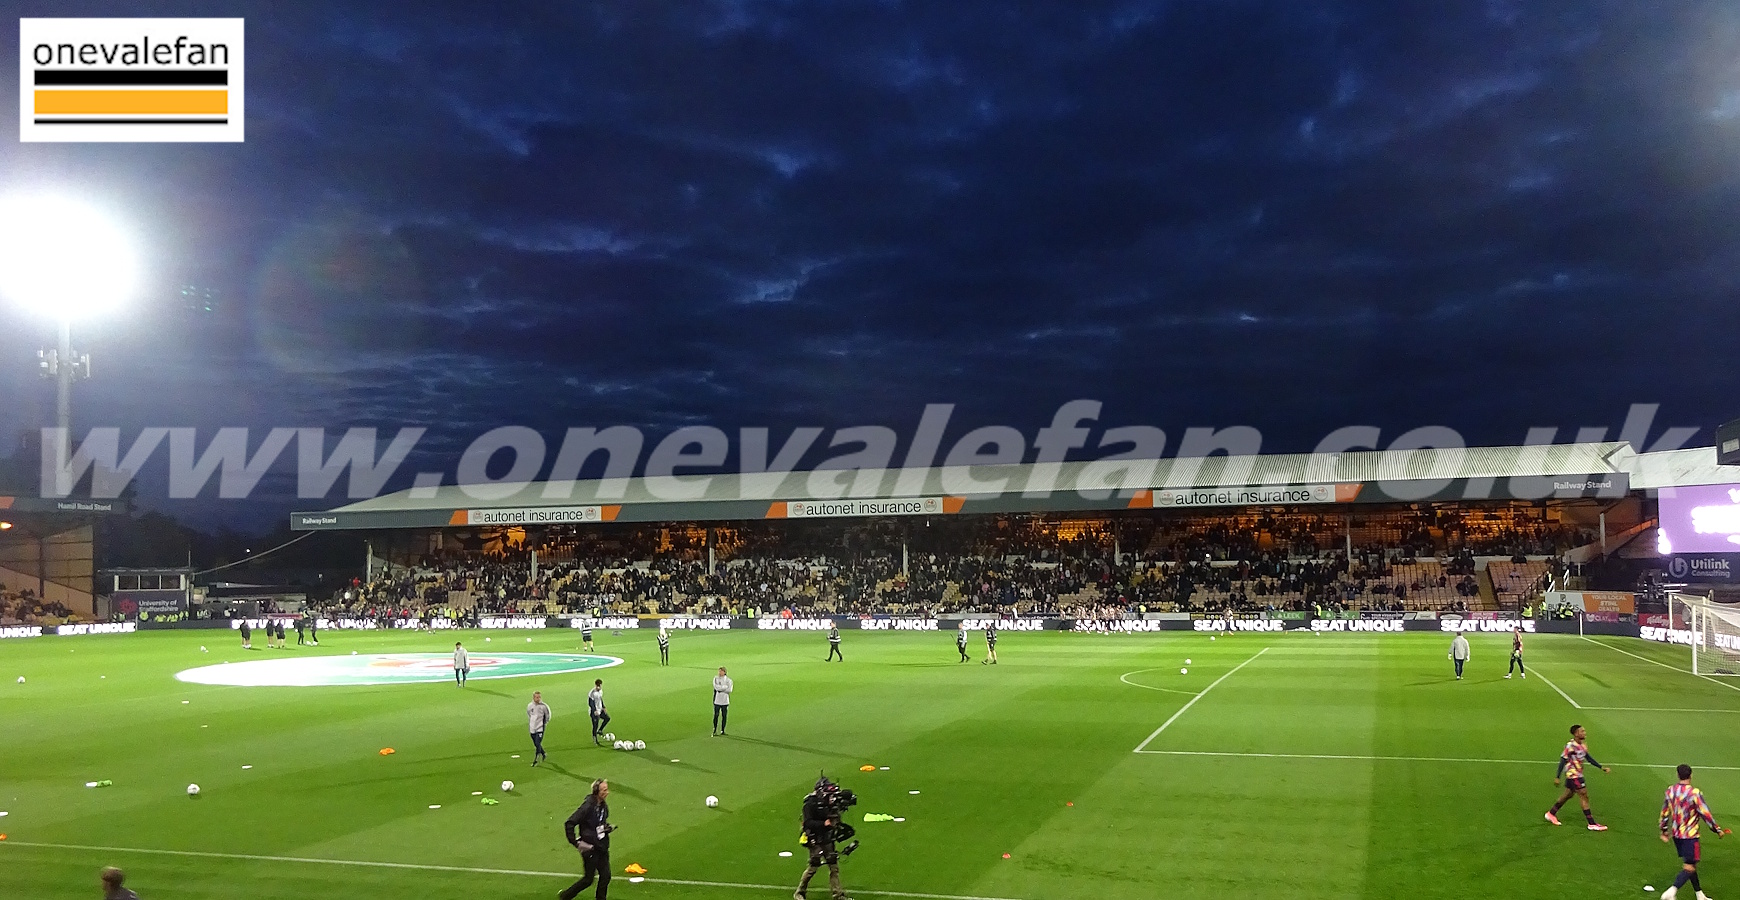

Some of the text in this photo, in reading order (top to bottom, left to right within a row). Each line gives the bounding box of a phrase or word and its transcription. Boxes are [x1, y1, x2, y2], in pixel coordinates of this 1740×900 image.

[1554, 480, 1612, 490] Railway Stand
[1175, 488, 1310, 505] autonet insurance
[57, 502, 76, 510] Hamil
[94, 503, 112, 511] Stand
[806, 500, 922, 516] autonet insurance
[302, 516, 337, 525] Railway Stand
[484, 509, 583, 523] autonet insurance
[1690, 558, 1730, 569] Utilink
[1691, 570, 1731, 578] Consulting
[57, 622, 136, 636] SEAT UNIQUE
[481, 618, 547, 629] SEAT UNIQUE
[659, 618, 689, 630] SEAT
[757, 618, 832, 630] SEAT UNIQUE
[860, 619, 939, 631] SEAT UNIQUE
[994, 619, 1044, 631] UNIQUE
[1229, 619, 1284, 632] UNIQUE
[1310, 619, 1404, 632] SEAT UNIQUE
[1440, 619, 1479, 632] SEAT
[1640, 626, 1667, 642] SEAT
